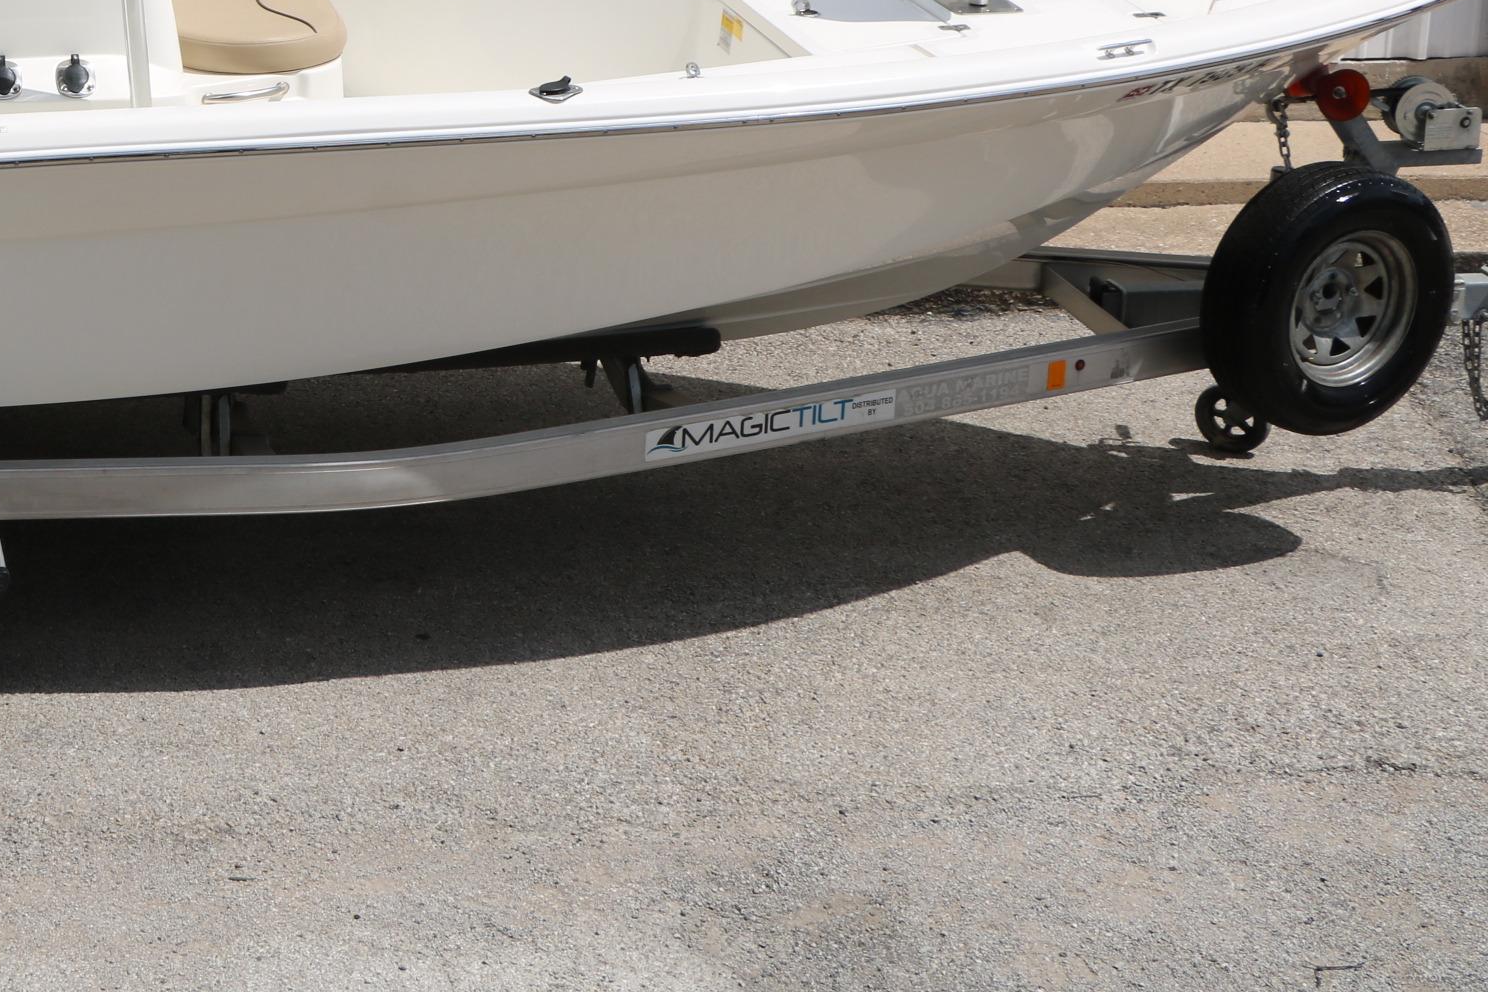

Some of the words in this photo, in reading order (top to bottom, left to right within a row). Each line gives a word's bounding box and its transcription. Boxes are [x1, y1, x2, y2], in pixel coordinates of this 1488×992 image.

[851, 396, 894, 410] DISTRIBUTED
[867, 408, 876, 416] BY
[681, 399, 854, 448] MAGICTILT
